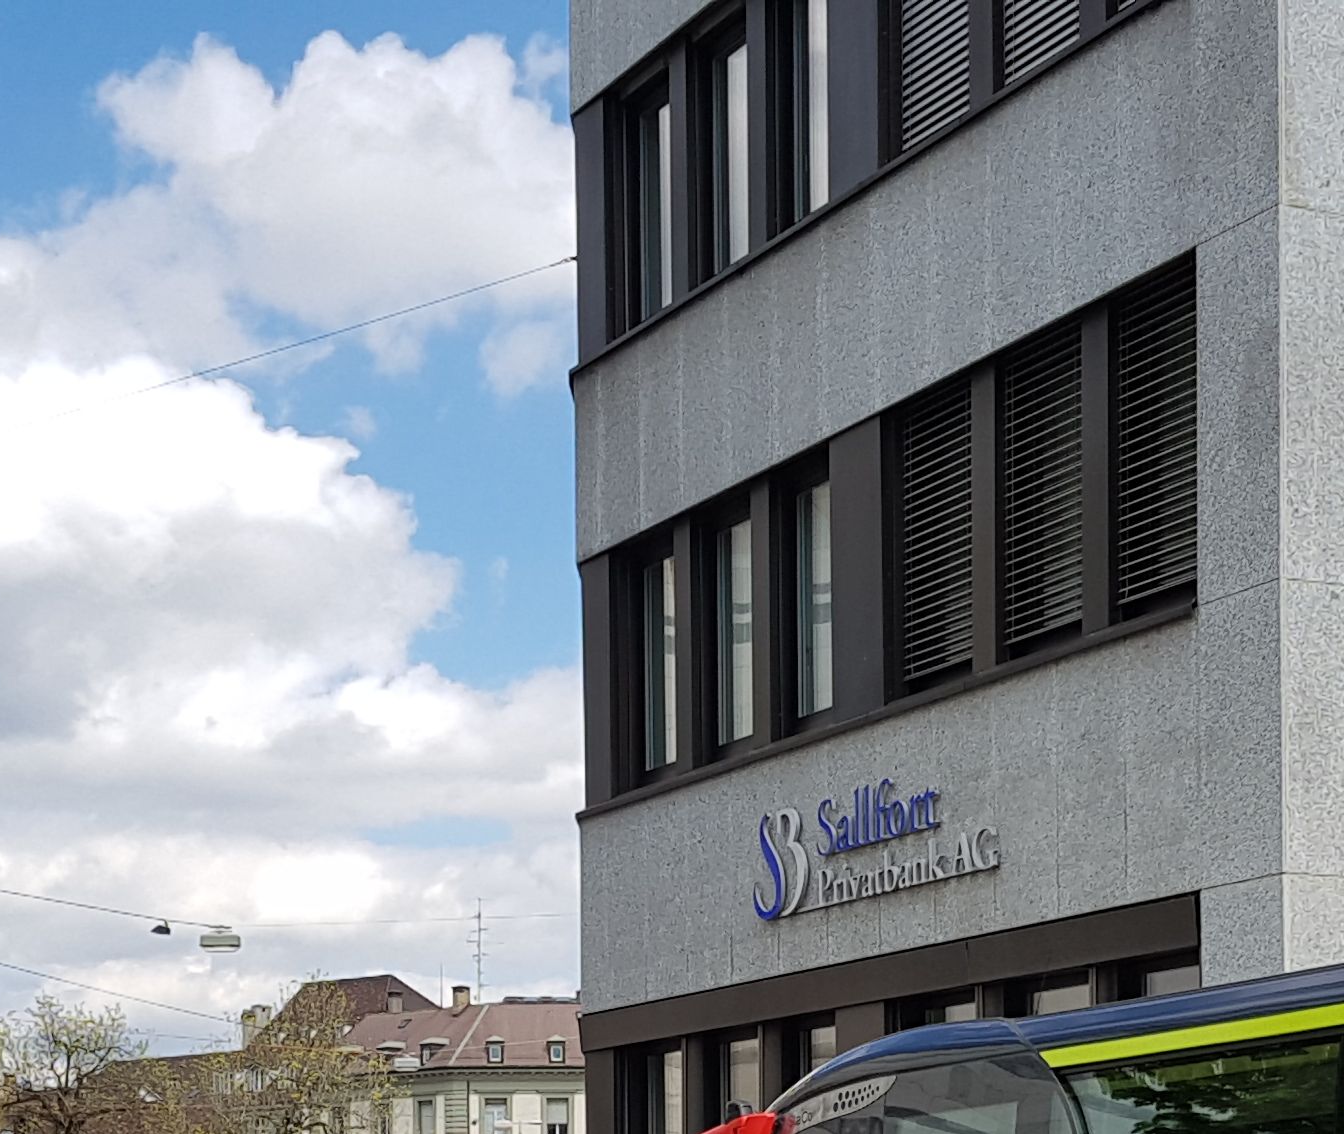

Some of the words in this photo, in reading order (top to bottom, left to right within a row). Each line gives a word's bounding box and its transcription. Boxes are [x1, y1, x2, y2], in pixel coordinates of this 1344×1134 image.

[817, 778, 941, 856] Sallfort
[818, 838, 947, 905] Privatbank
[953, 827, 1000, 874] AG
